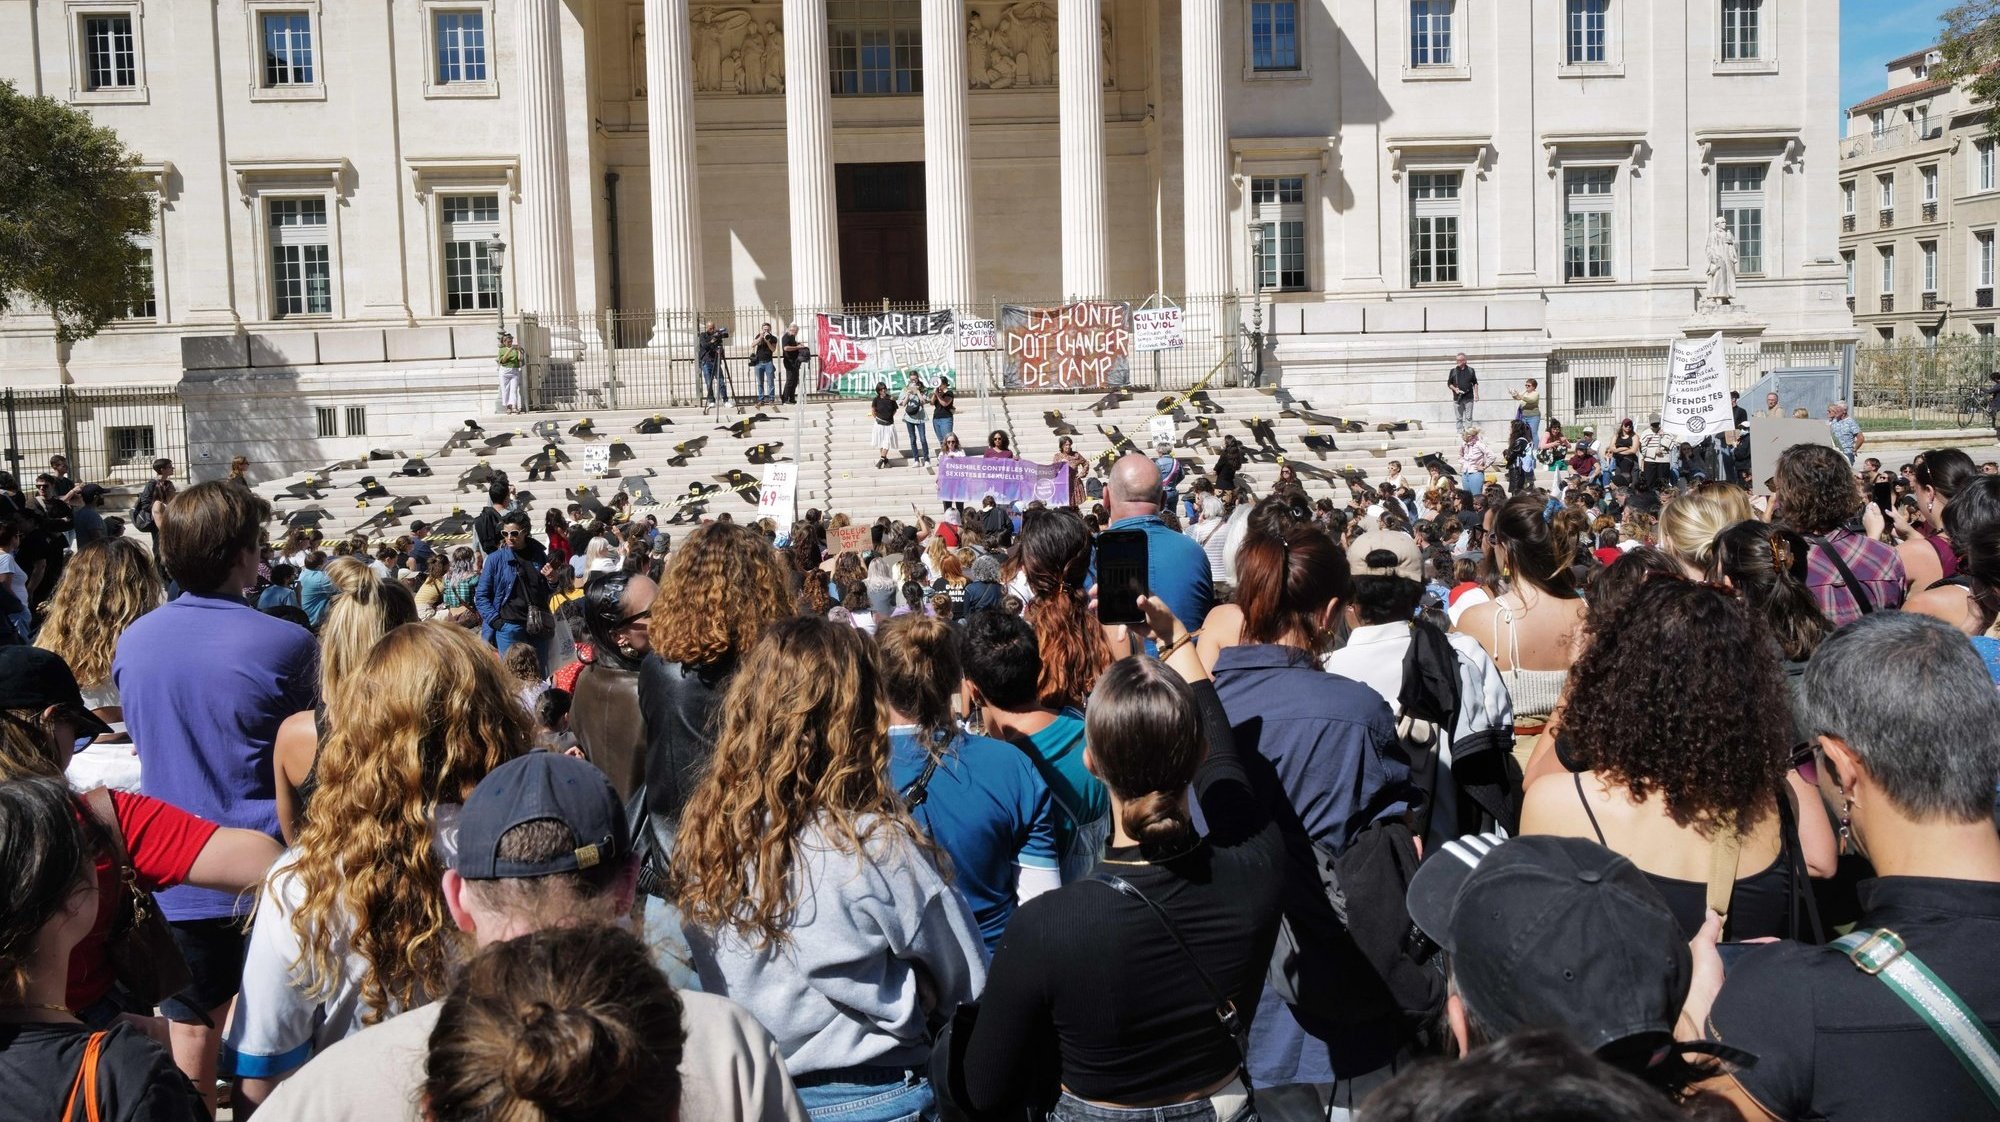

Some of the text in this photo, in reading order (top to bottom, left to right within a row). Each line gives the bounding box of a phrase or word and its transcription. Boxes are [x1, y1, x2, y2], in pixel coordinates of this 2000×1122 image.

[1027, 302, 1123, 331] LA HONTE
[1133, 311, 1179, 321] CULTURE
[974, 320, 995, 329] CORPS
[1150, 321, 1175, 329] VIOL
[962, 335, 996, 348] JOUETS
[1056, 328, 1128, 356] CHANGER
[1168, 338, 1185, 347] YEUX
[827, 338, 865, 363] AVEC
[1024, 356, 1112, 387] DE CAMP
[821, 372, 842, 392] DU
[848, 371, 898, 394] MONDE
[1708, 391, 1724, 402] TES
[1676, 404, 1714, 415] SOEURS
[945, 462, 981, 471] ENSEMBLE
[761, 490, 777, 506] 49
[830, 526, 866, 537] VIOLEUR
[841, 540, 858, 549] VOIT
